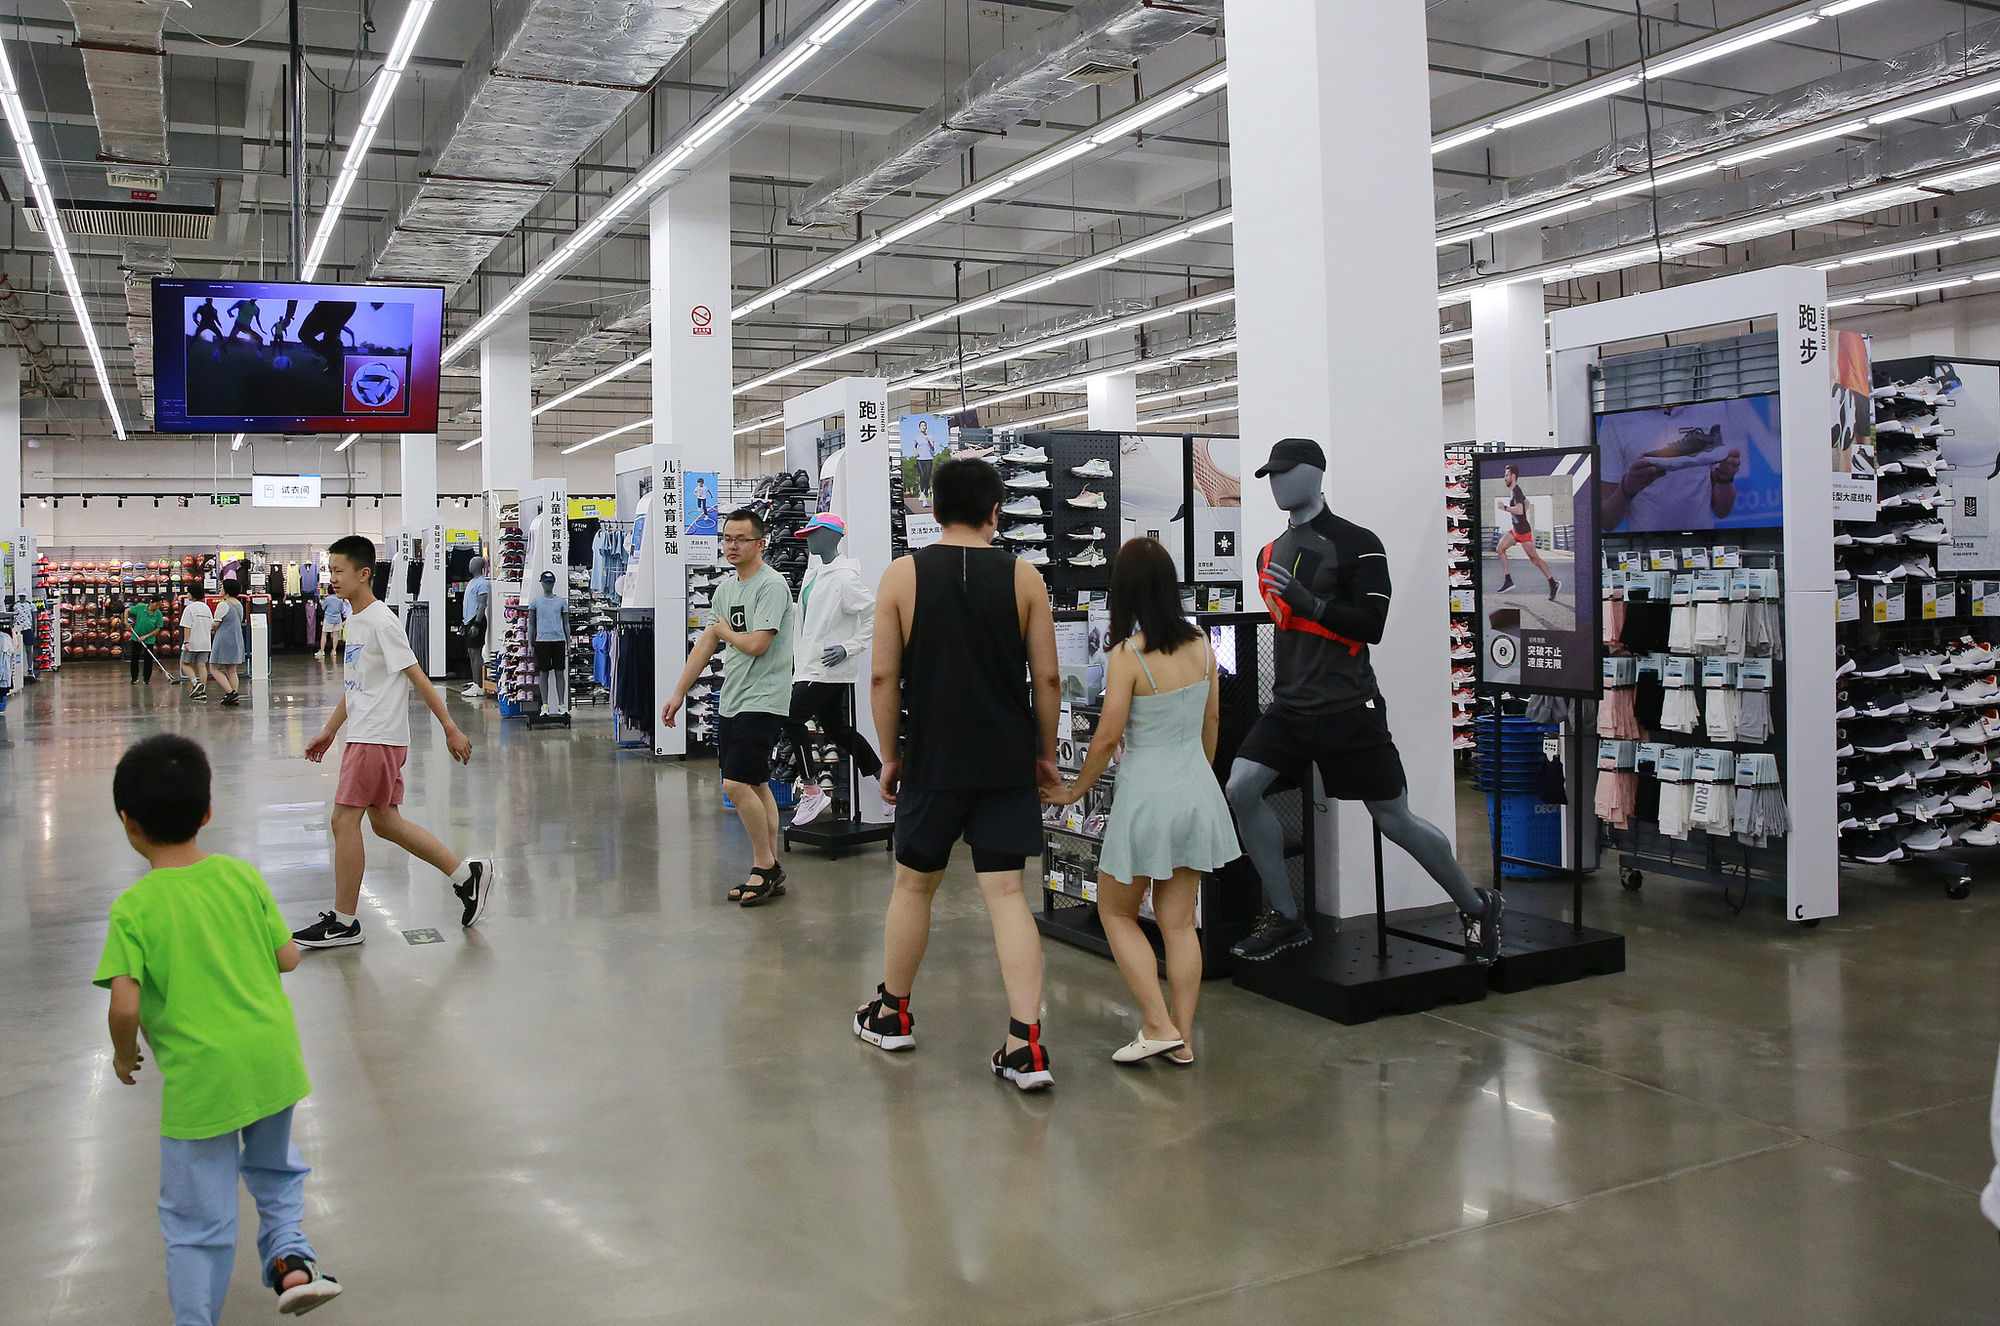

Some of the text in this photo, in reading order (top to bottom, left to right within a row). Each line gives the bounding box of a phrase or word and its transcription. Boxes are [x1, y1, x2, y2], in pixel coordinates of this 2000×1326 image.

[1798, 304, 1818, 365] 跑步
[1819, 306, 1827, 351] RUNNING
[858, 400, 878, 443] 跑步
[281, 485, 310, 495] 试衣间
[662, 460, 679, 555] 儿童体育基础
[550, 490, 563, 564] 儿童体育基础
[1527, 645, 1562, 658] 突破不止
[1527, 657, 1562, 670] 速度无限
